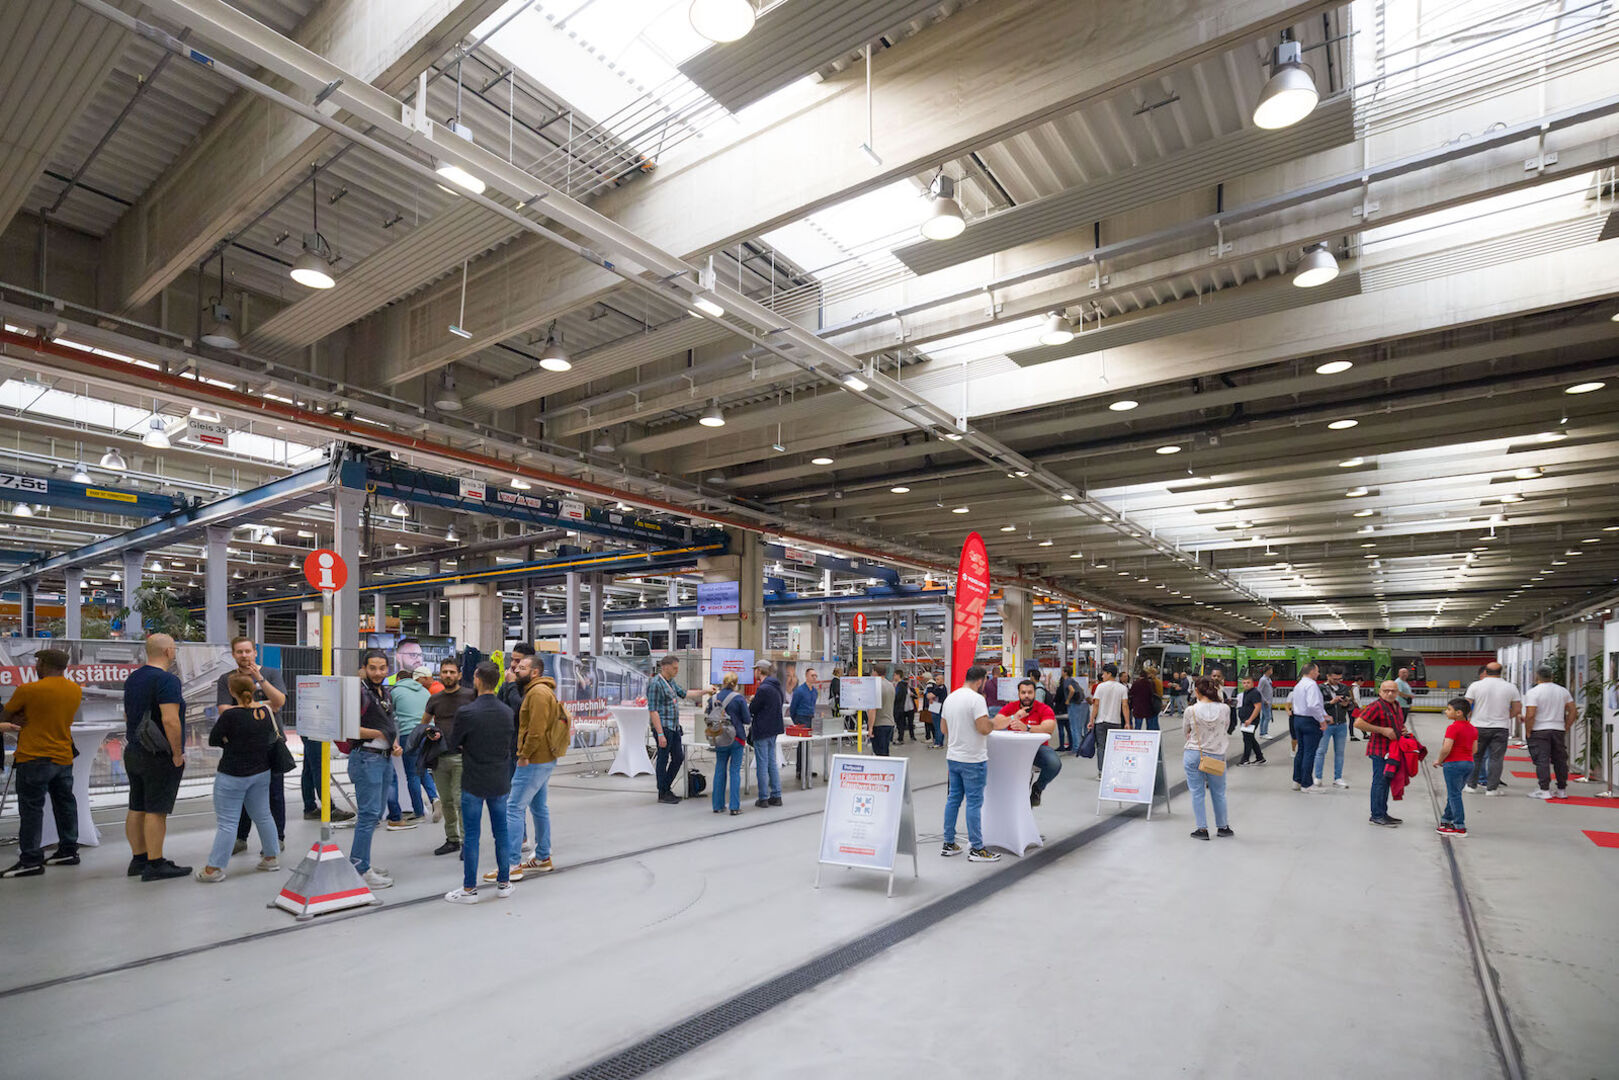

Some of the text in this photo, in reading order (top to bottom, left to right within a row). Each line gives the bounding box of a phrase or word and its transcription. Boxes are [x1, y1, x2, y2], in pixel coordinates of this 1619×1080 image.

[190, 420, 227, 434] Gleis 35
[0, 474, 46, 490] 7,5t
[19, 665, 138, 684] Wkstätte
[564, 699, 606, 712] tentechnik
